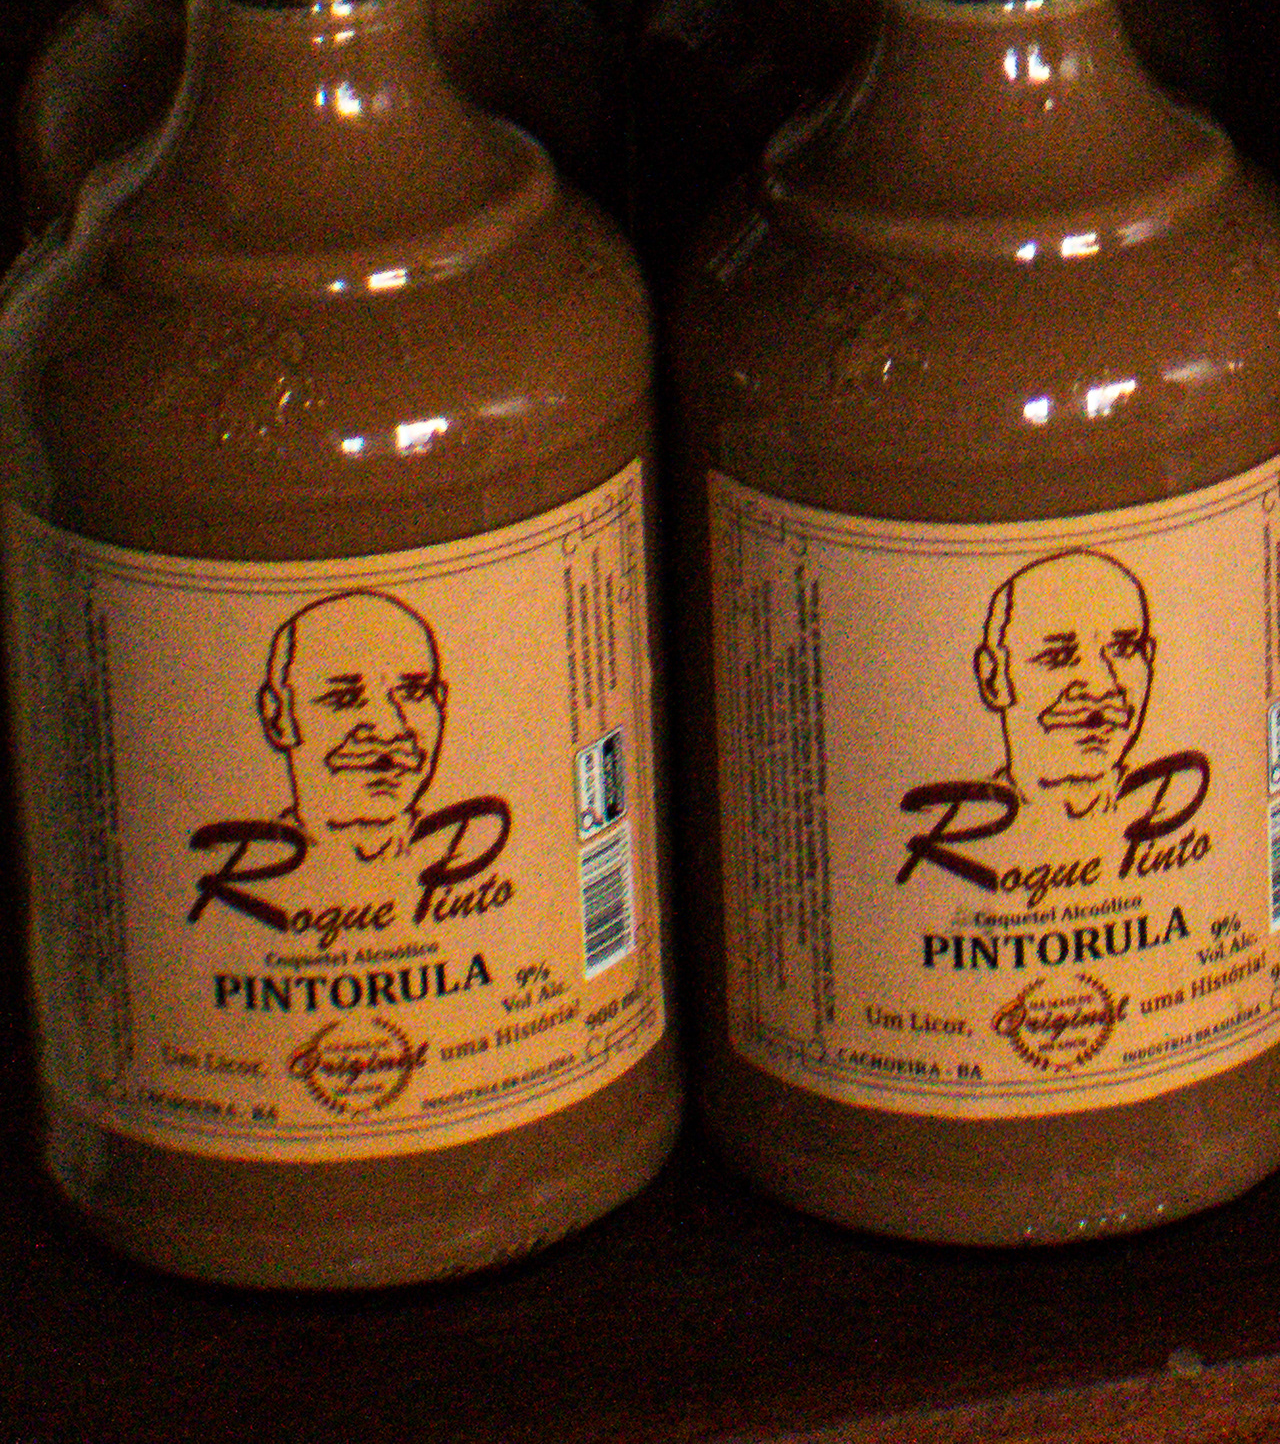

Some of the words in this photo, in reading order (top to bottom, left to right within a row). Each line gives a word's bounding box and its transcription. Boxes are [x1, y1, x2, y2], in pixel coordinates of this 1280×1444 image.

[895, 779, 1102, 909] Roque
[1117, 749, 1212, 881] Pinto
[186, 819, 396, 951] Roque
[410, 795, 516, 926] Pinto
[973, 908, 1057, 930] Coquetel
[1062, 894, 1144, 921] Alcoólico
[1209, 912, 1241, 940] 9%
[922, 905, 1191, 971] PINTORULA
[1196, 942, 1227, 966] Vol
[213, 951, 493, 1013] PINTORULA
[1139, 988, 1186, 1015] uma
[1190, 950, 1267, 999] História!
[440, 1037, 488, 1062] uma
[495, 999, 580, 1050] História!
[865, 1005, 901, 1031] Um
[908, 1011, 973, 1039] Licor,
[990, 994, 1131, 1037] Original
[288, 1038, 429, 1081] Original
[836, 1047, 937, 1078] CACHOEIRA
[957, 1061, 983, 1081] BA
